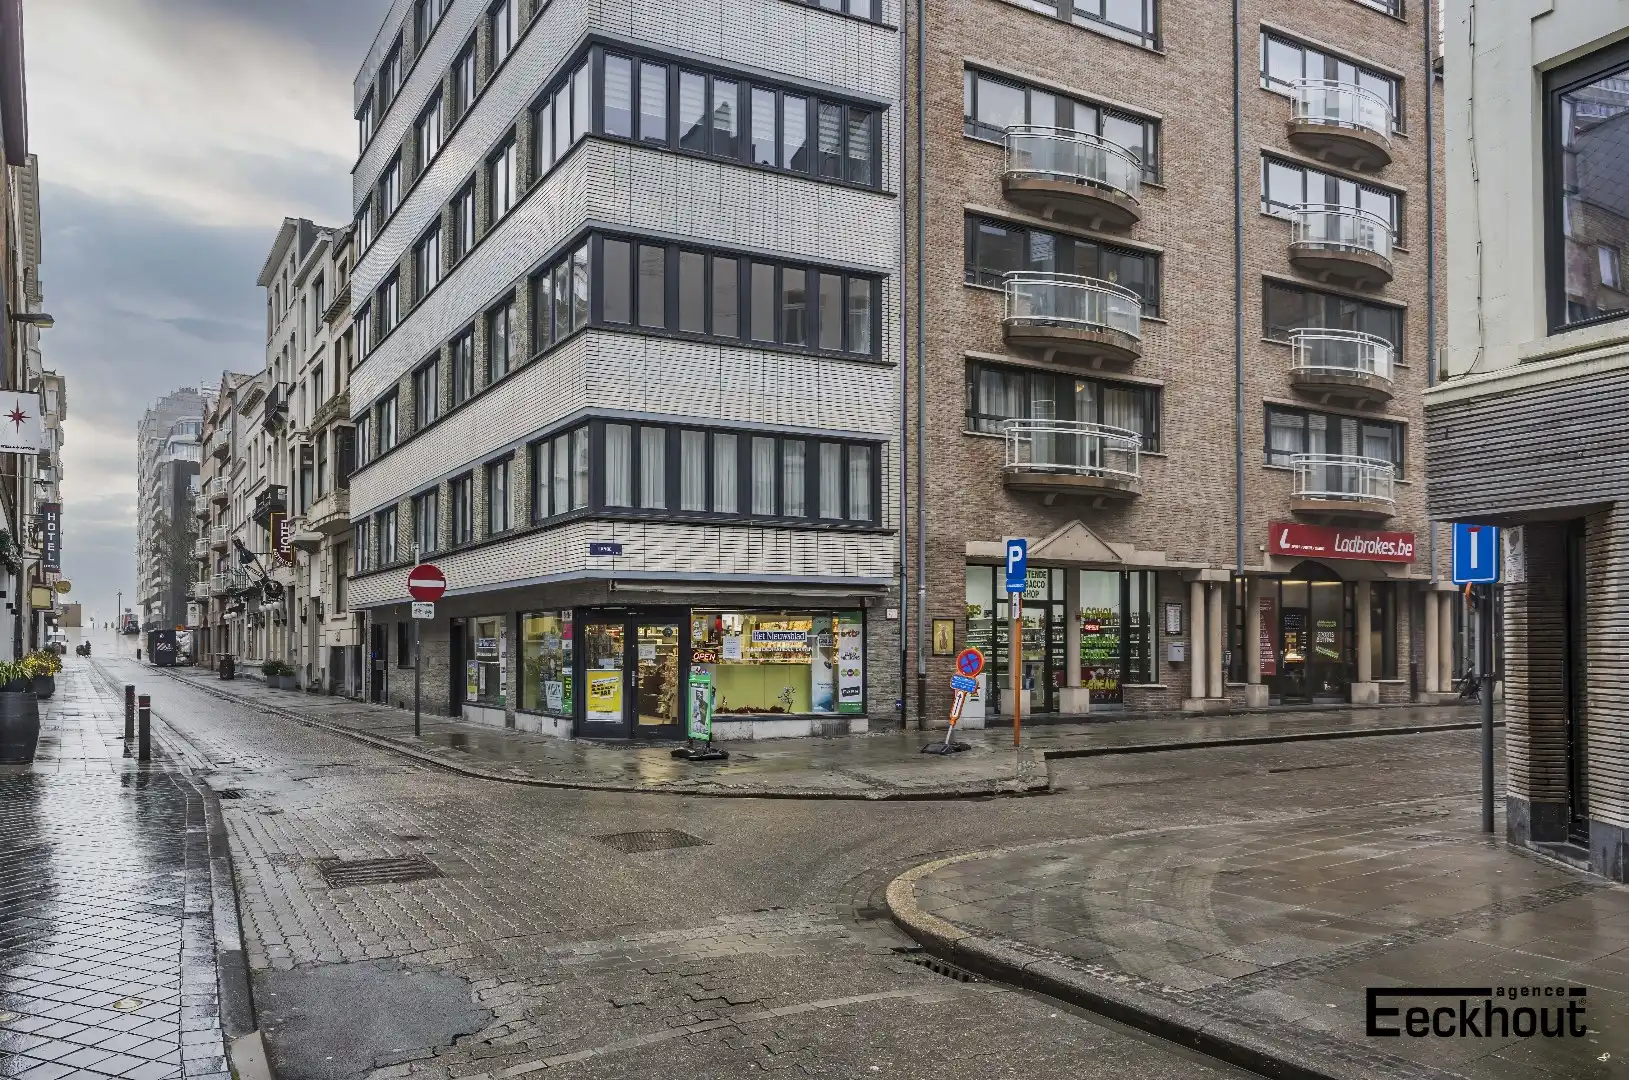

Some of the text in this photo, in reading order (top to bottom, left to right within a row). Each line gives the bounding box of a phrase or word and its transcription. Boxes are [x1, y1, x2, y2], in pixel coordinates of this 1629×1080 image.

[47, 512, 56, 561] HOTEL
[1334, 533, 1413, 556] Ladbrokes.be
[1008, 545, 1023, 574] P
[1023, 589, 1040, 599] SHOP
[754, 631, 806, 641] Het Nieuwsblad
[693, 652, 716, 661] OPEN
